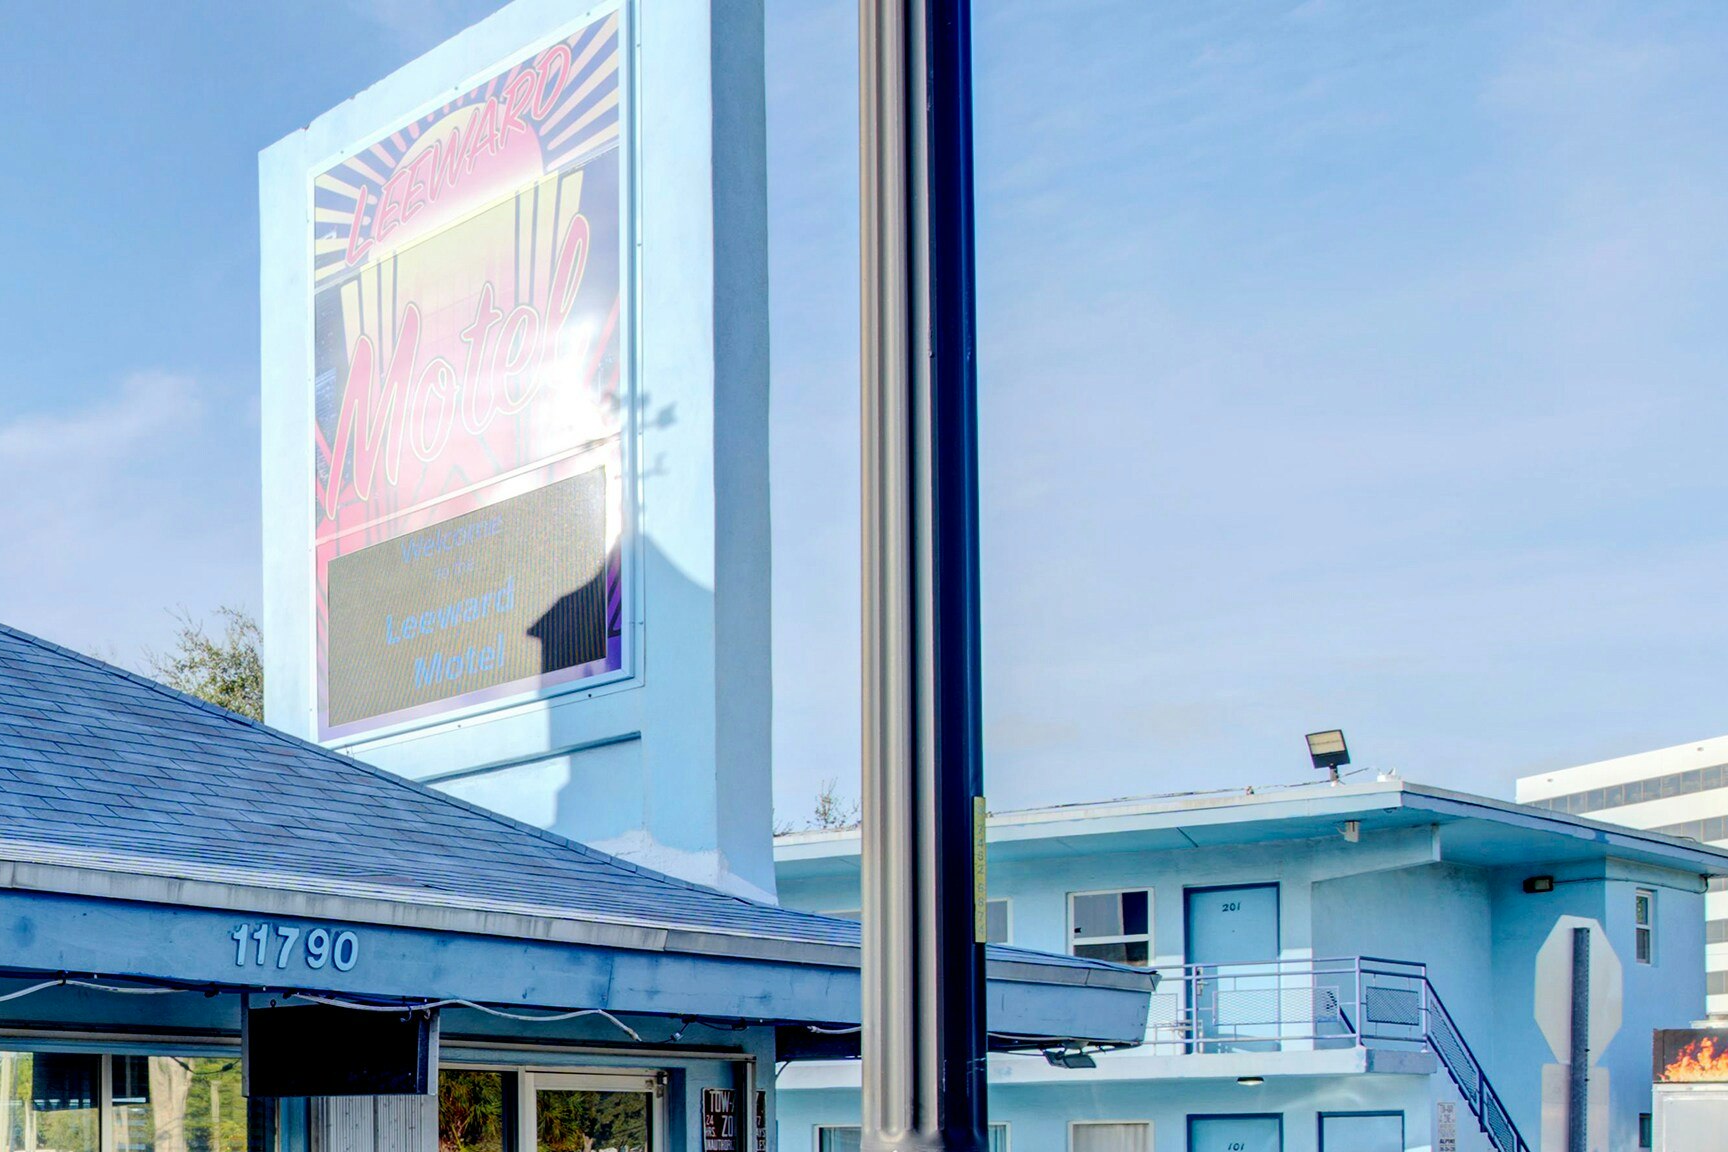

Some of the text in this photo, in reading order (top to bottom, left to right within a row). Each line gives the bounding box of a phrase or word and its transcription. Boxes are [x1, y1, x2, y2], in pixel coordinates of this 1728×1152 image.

[344, 43, 573, 267] LEEWARD
[325, 213, 590, 520] Motel
[400, 513, 503, 564] Welcome
[386, 575, 515, 645] Leeward
[415, 632, 505, 690] Motel
[1222, 902, 1241, 912] 201
[232, 923, 359, 972] 11790
[722, 1115, 733, 1137] ZO
[1227, 1142, 1245, 1151] 101
